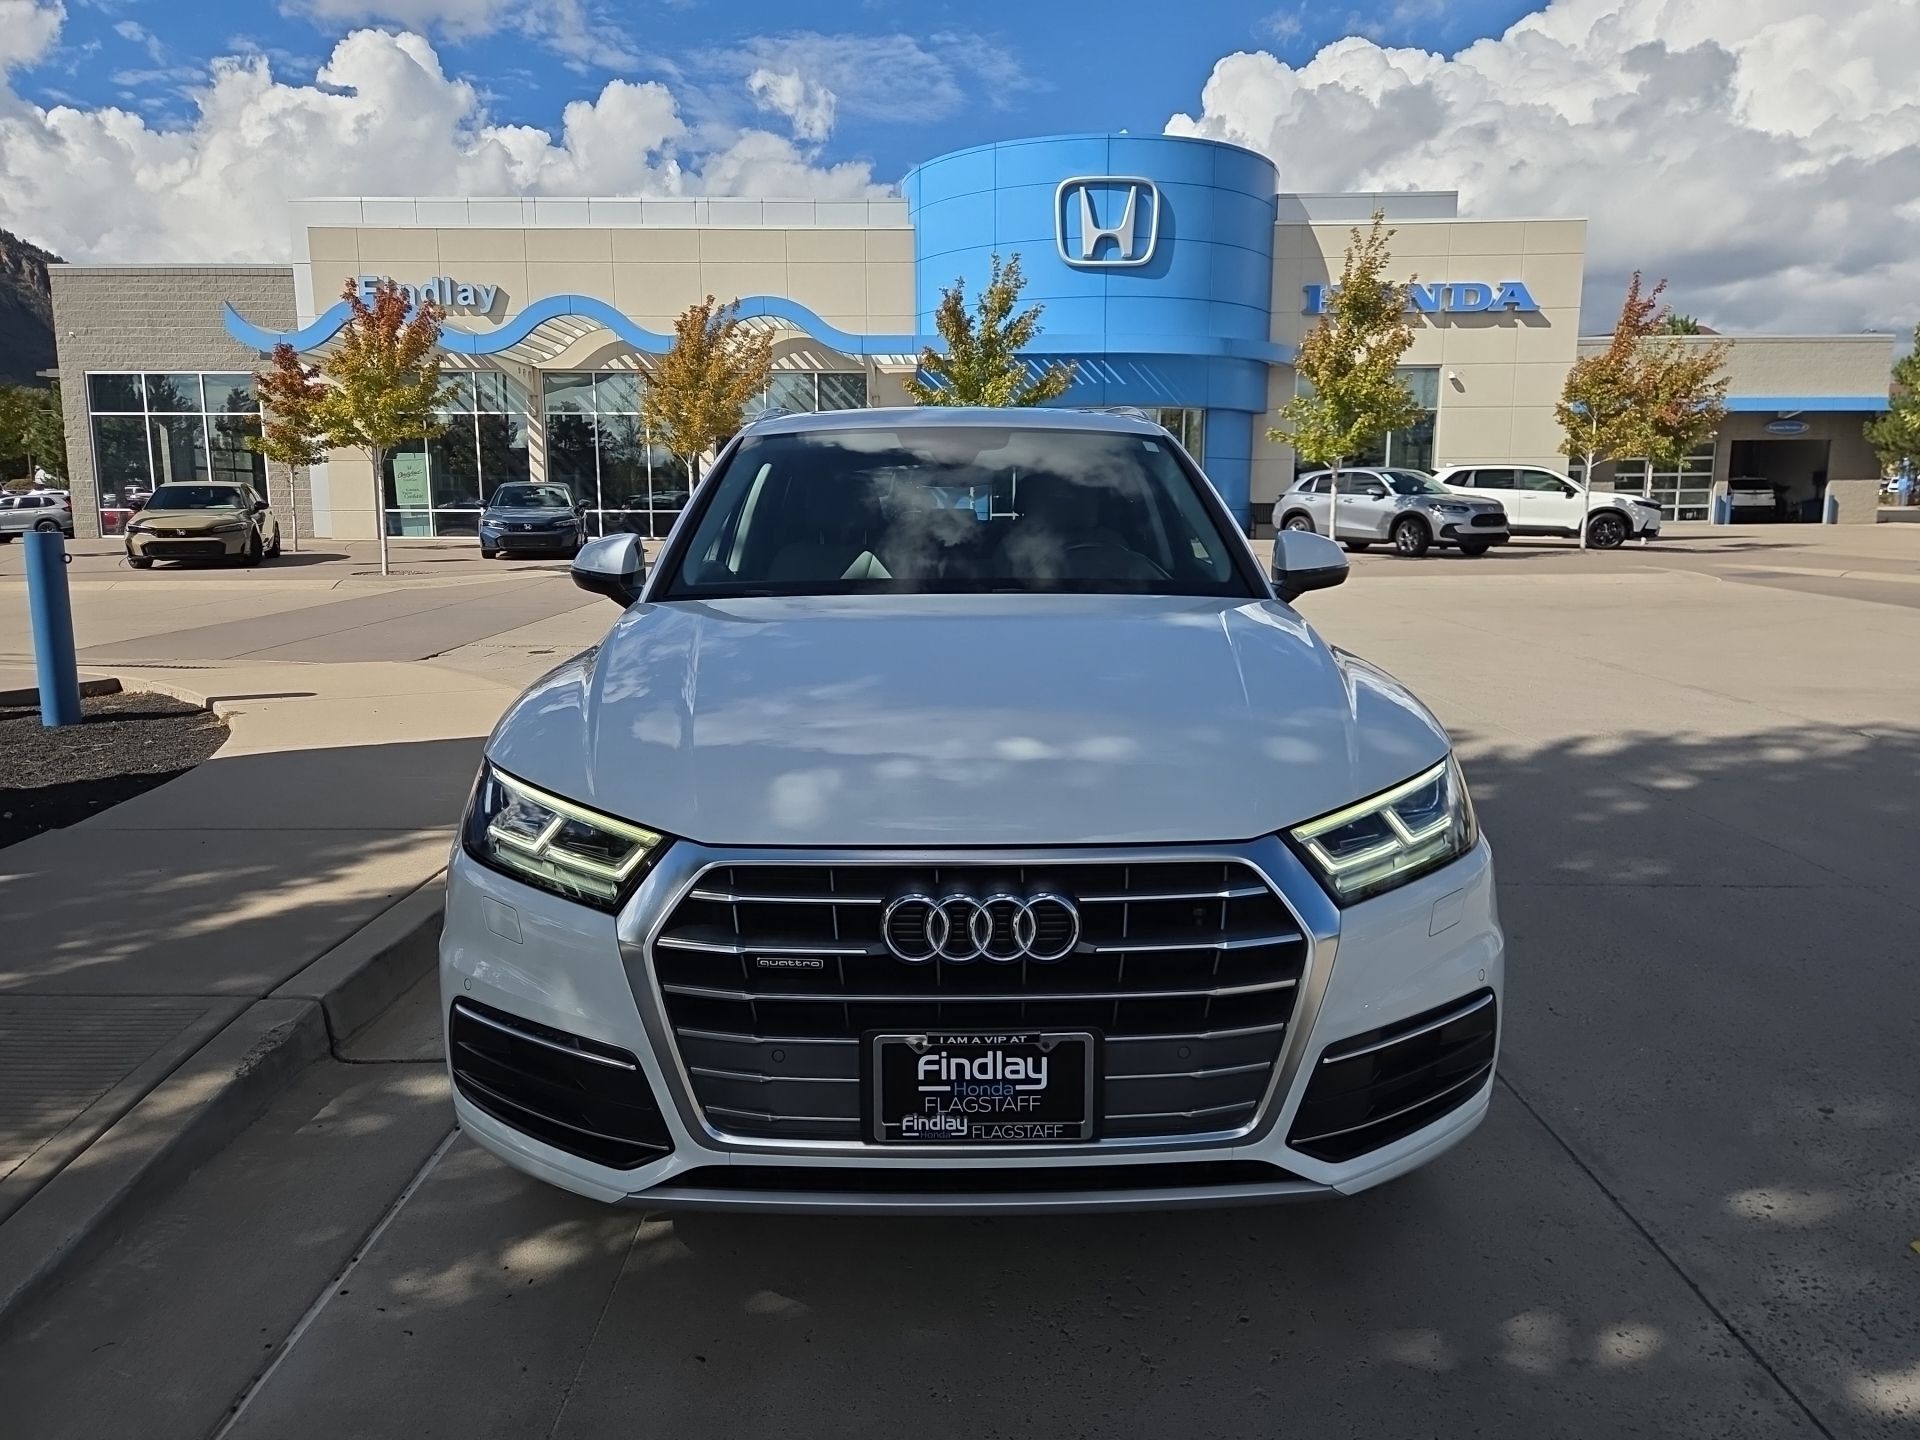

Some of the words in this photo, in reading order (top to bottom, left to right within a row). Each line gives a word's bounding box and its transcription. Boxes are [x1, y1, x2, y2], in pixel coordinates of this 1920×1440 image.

[1302, 281, 1541, 315] HNDA
[940, 1036, 944, 1044] I
[947, 1036, 968, 1044] AM
[971, 1036, 981, 1044] A
[984, 1035, 1007, 1044] VIP
[1010, 1035, 1027, 1043] AT
[918, 1051, 1048, 1090] Findlay
[954, 1082, 1014, 1096] Honda
[925, 1096, 1042, 1113] FLAGSTAFF
[902, 1114, 968, 1136] Findlay
[972, 1125, 1064, 1139] FLAGSTAFF
[920, 1130, 951, 1139] Honda
